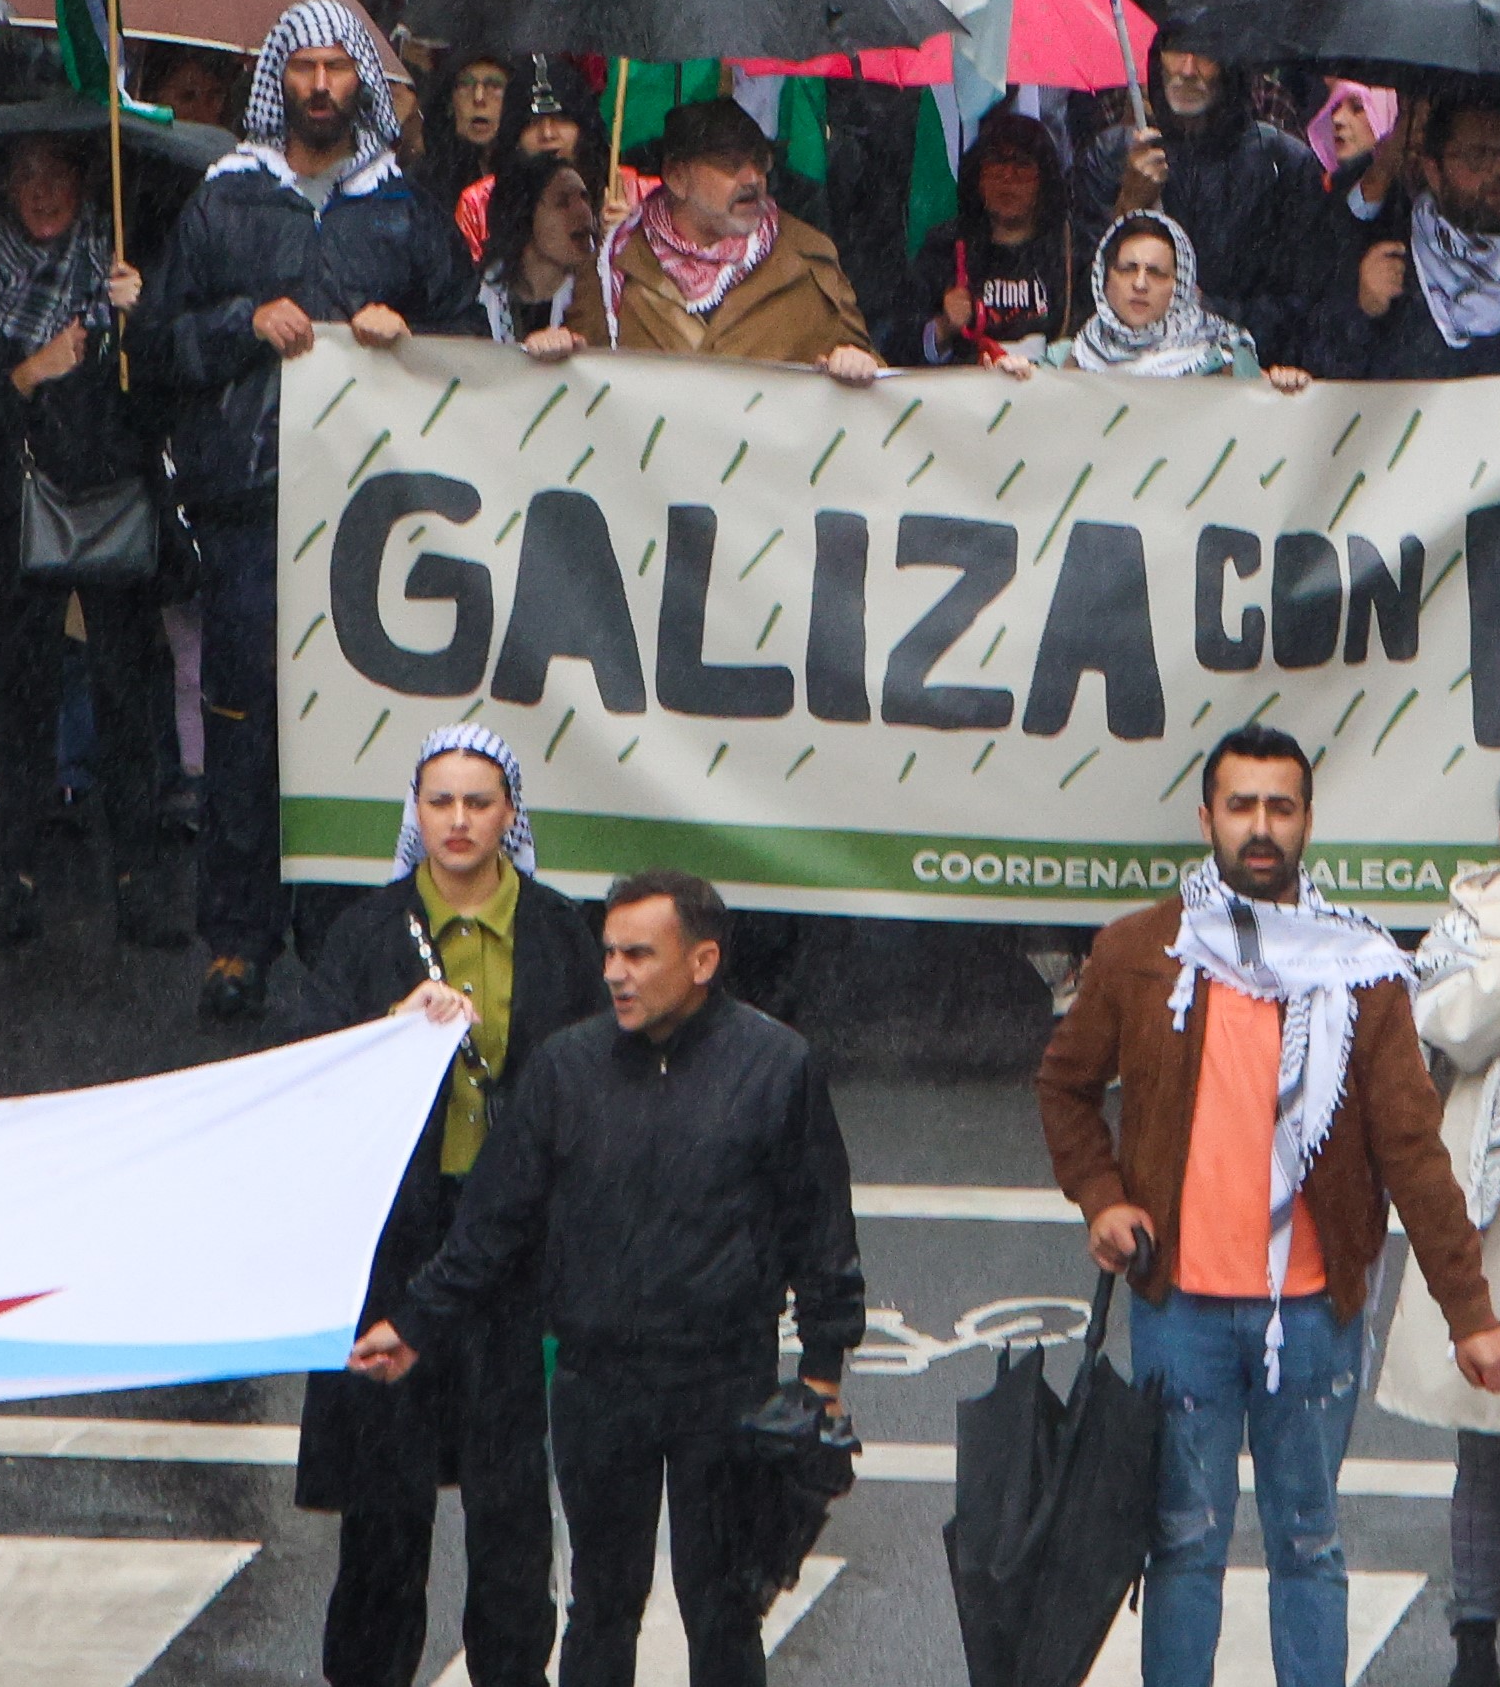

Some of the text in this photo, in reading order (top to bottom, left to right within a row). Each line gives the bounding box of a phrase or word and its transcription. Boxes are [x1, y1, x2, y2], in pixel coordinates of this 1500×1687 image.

[982, 278, 1030, 308] STINA
[329, 469, 1166, 741] GALIZA
[1194, 523, 1426, 672] CON
[912, 849, 1201, 890] COORDENAD
[1308, 857, 1445, 892] ALEGA
